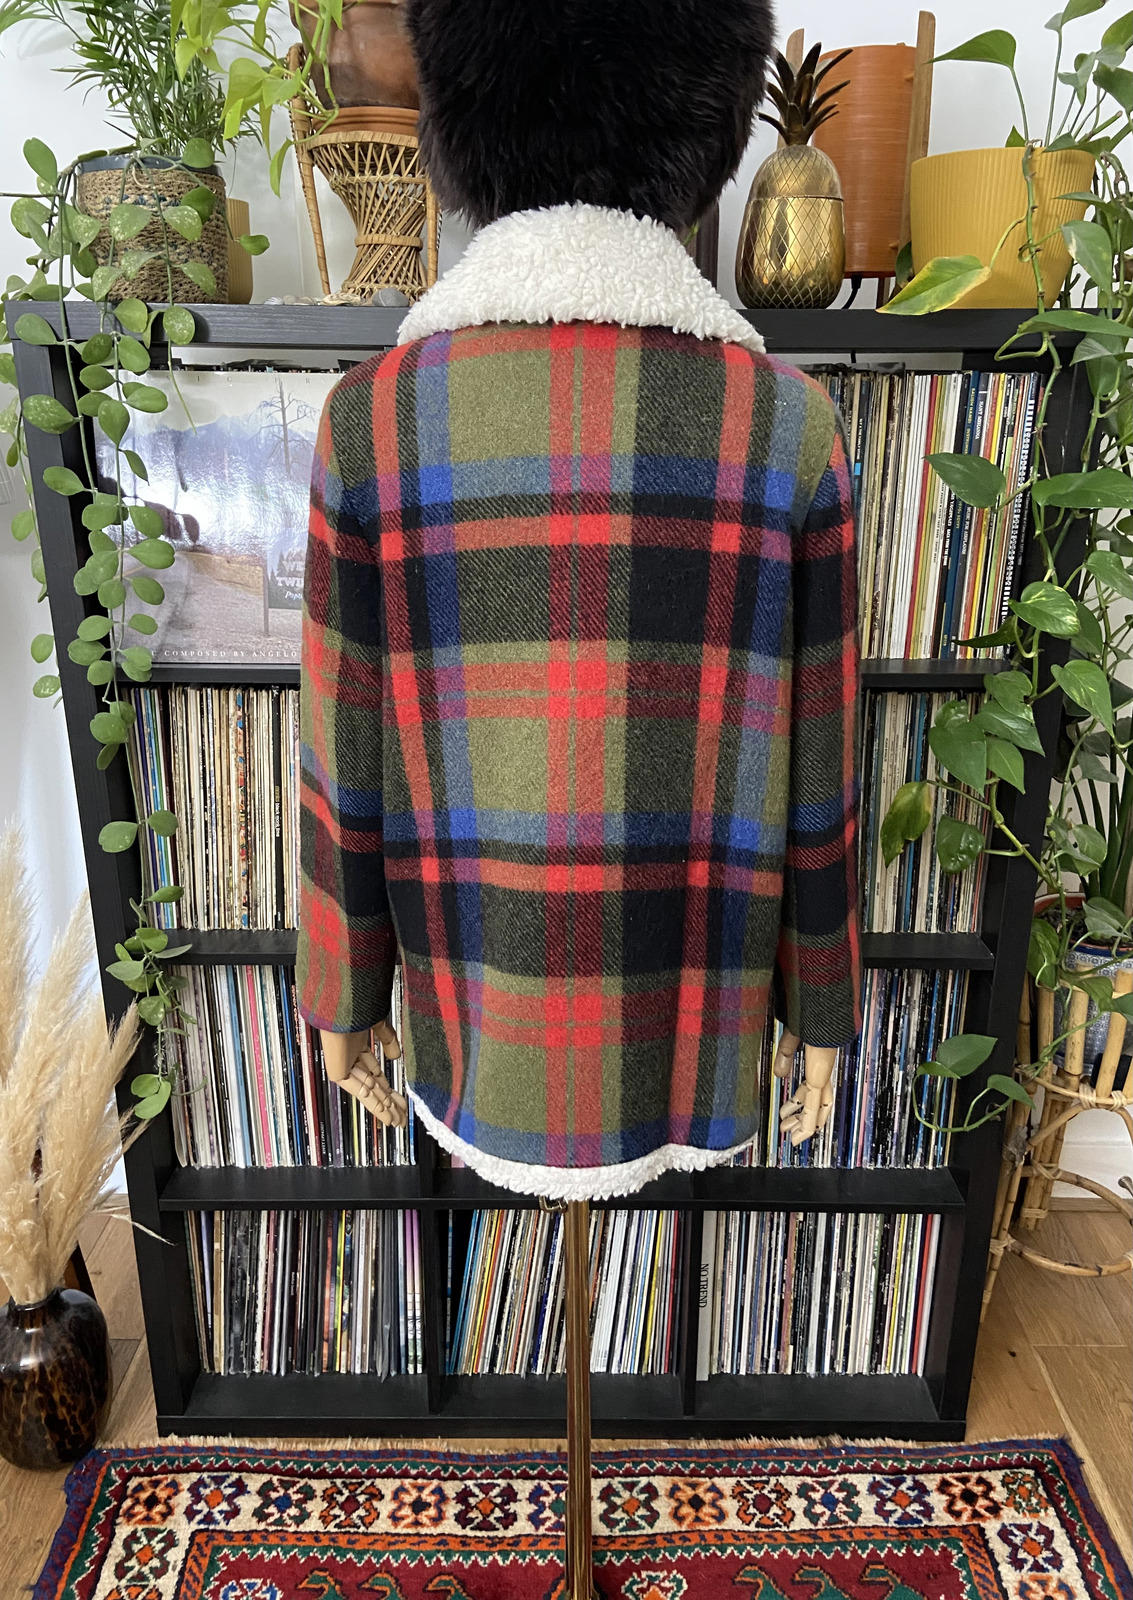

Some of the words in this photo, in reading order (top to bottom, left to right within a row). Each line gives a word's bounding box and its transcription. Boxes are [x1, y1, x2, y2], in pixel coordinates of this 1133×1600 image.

[276, 576, 304, 588] TWI
[700, 1264, 709, 1276] NO
[698, 1278, 708, 1308] TREND
